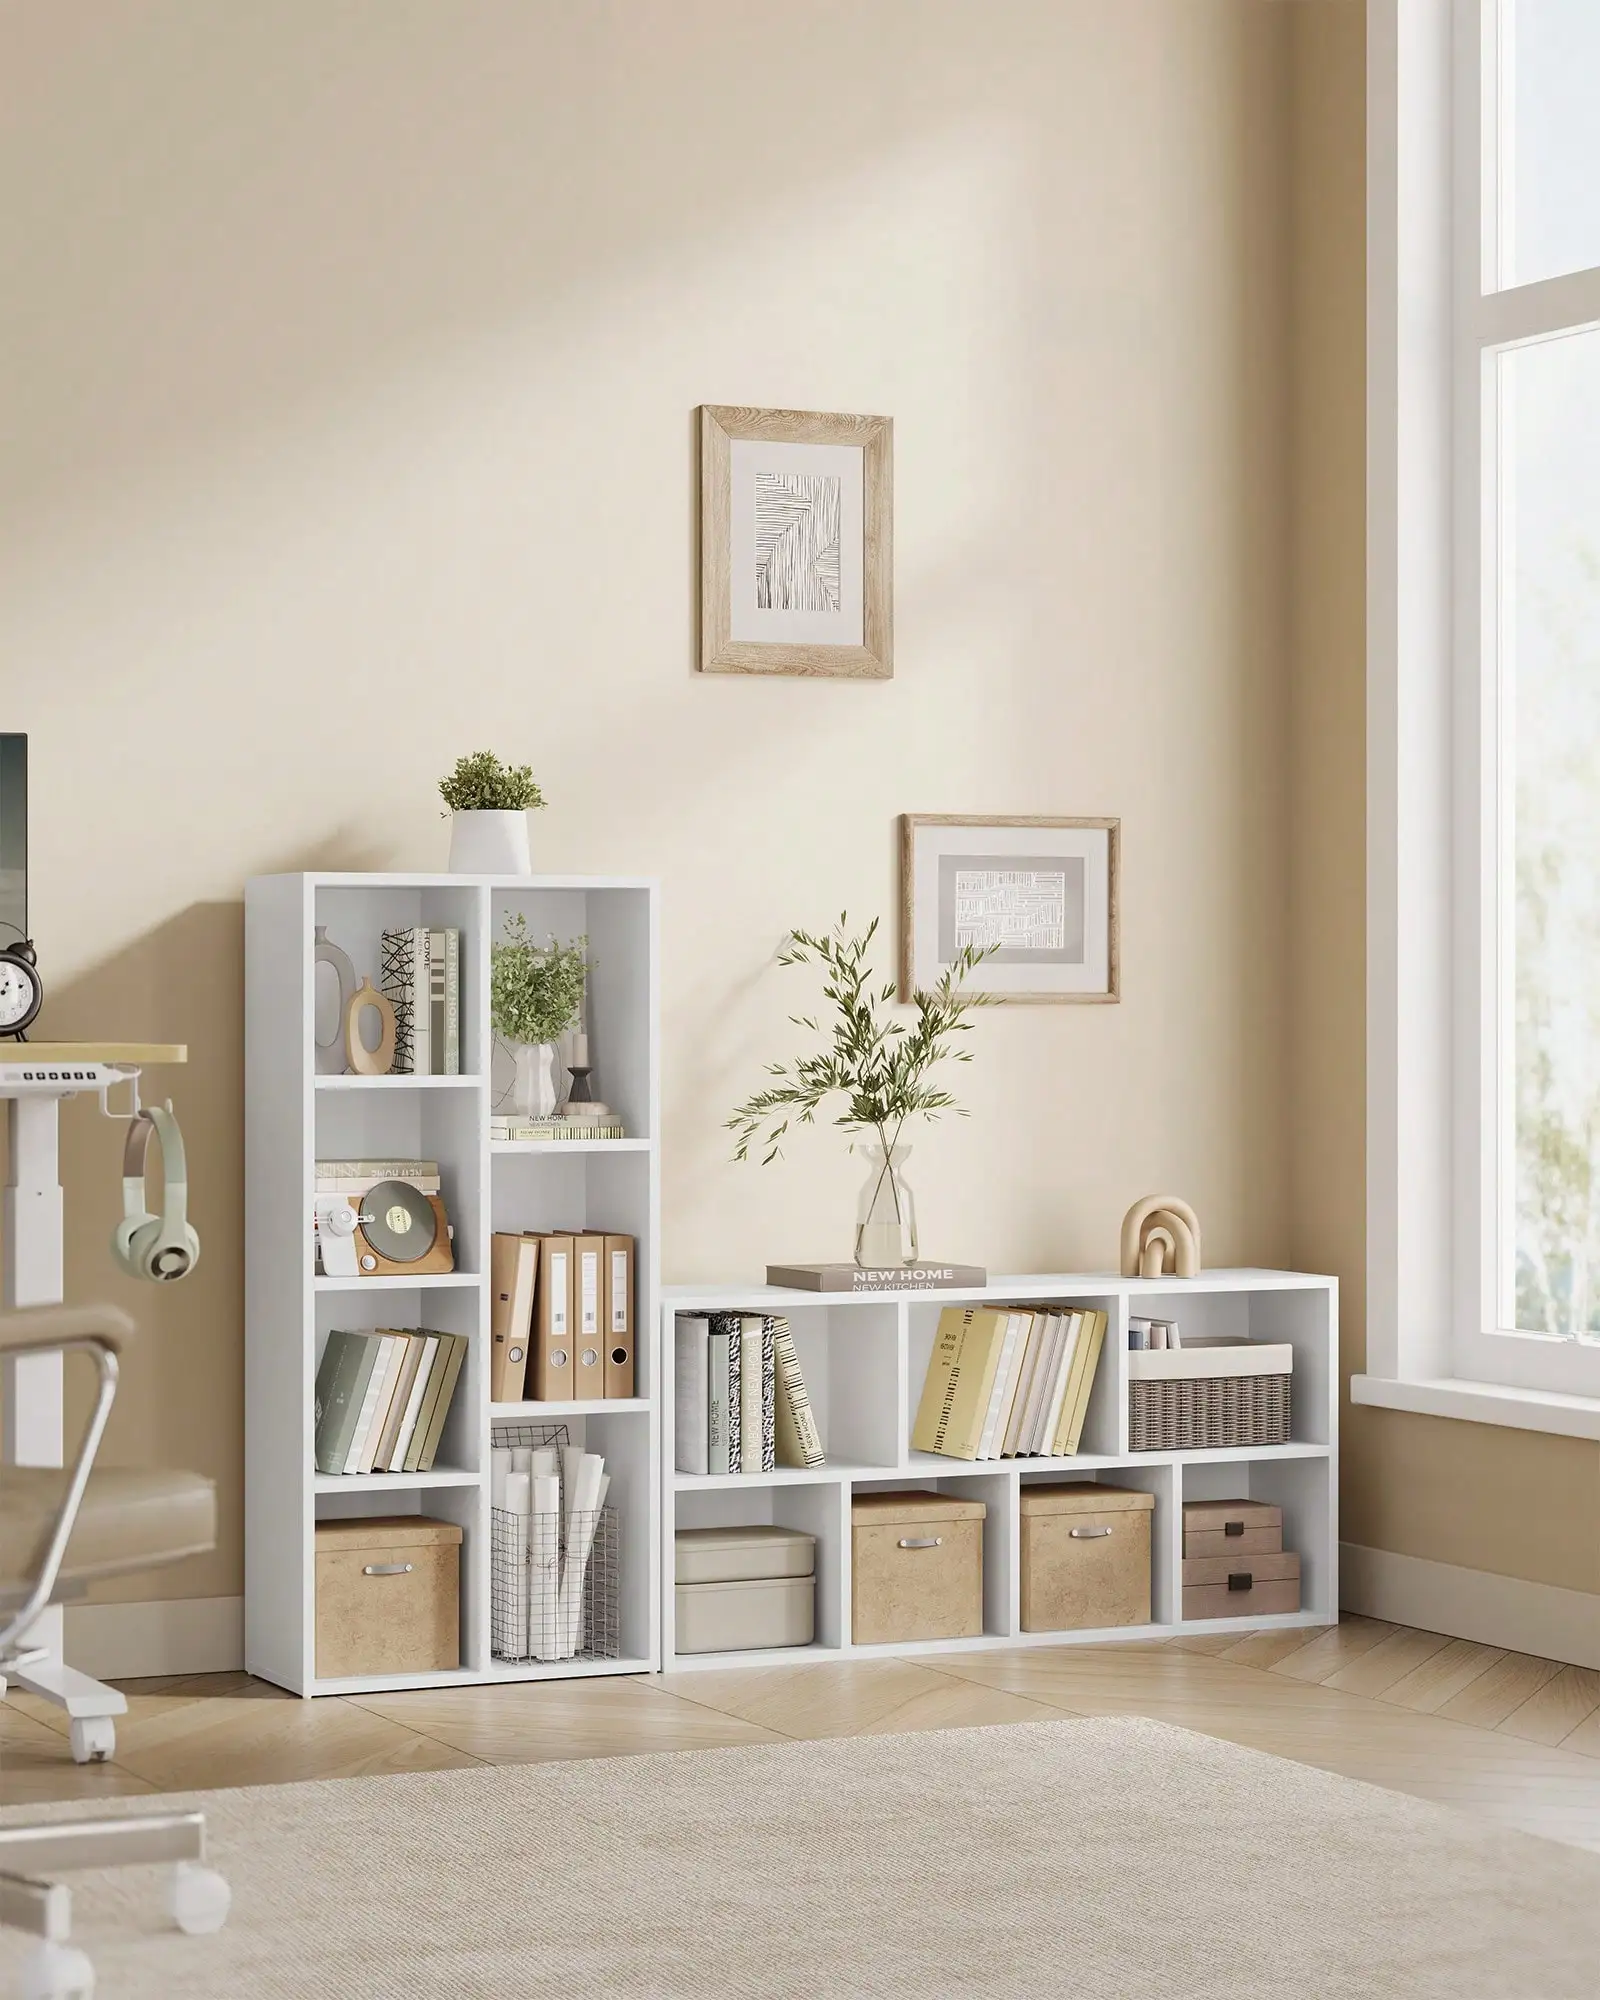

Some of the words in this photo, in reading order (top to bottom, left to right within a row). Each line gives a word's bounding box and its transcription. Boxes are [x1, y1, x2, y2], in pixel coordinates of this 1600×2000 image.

[449, 931, 457, 957] ART
[449, 962, 457, 994] NEW
[449, 996, 457, 1038] HOME
[853, 1271, 895, 1282] NEW
[900, 1269, 953, 1280] HOME
[853, 1283, 882, 1292] NEW
[885, 1282, 935, 1291] KITCHEN
[748, 1339, 759, 1370] HOME
[748, 1373, 759, 1396] NEW
[711, 1400, 719, 1425] HOME
[748, 1398, 759, 1418] ART
[799, 1412, 808, 1432] HOME
[711, 1427, 719, 1446] NEW
[748, 1420, 759, 1460] SYMBOL
[805, 1433, 813, 1448] NEW
